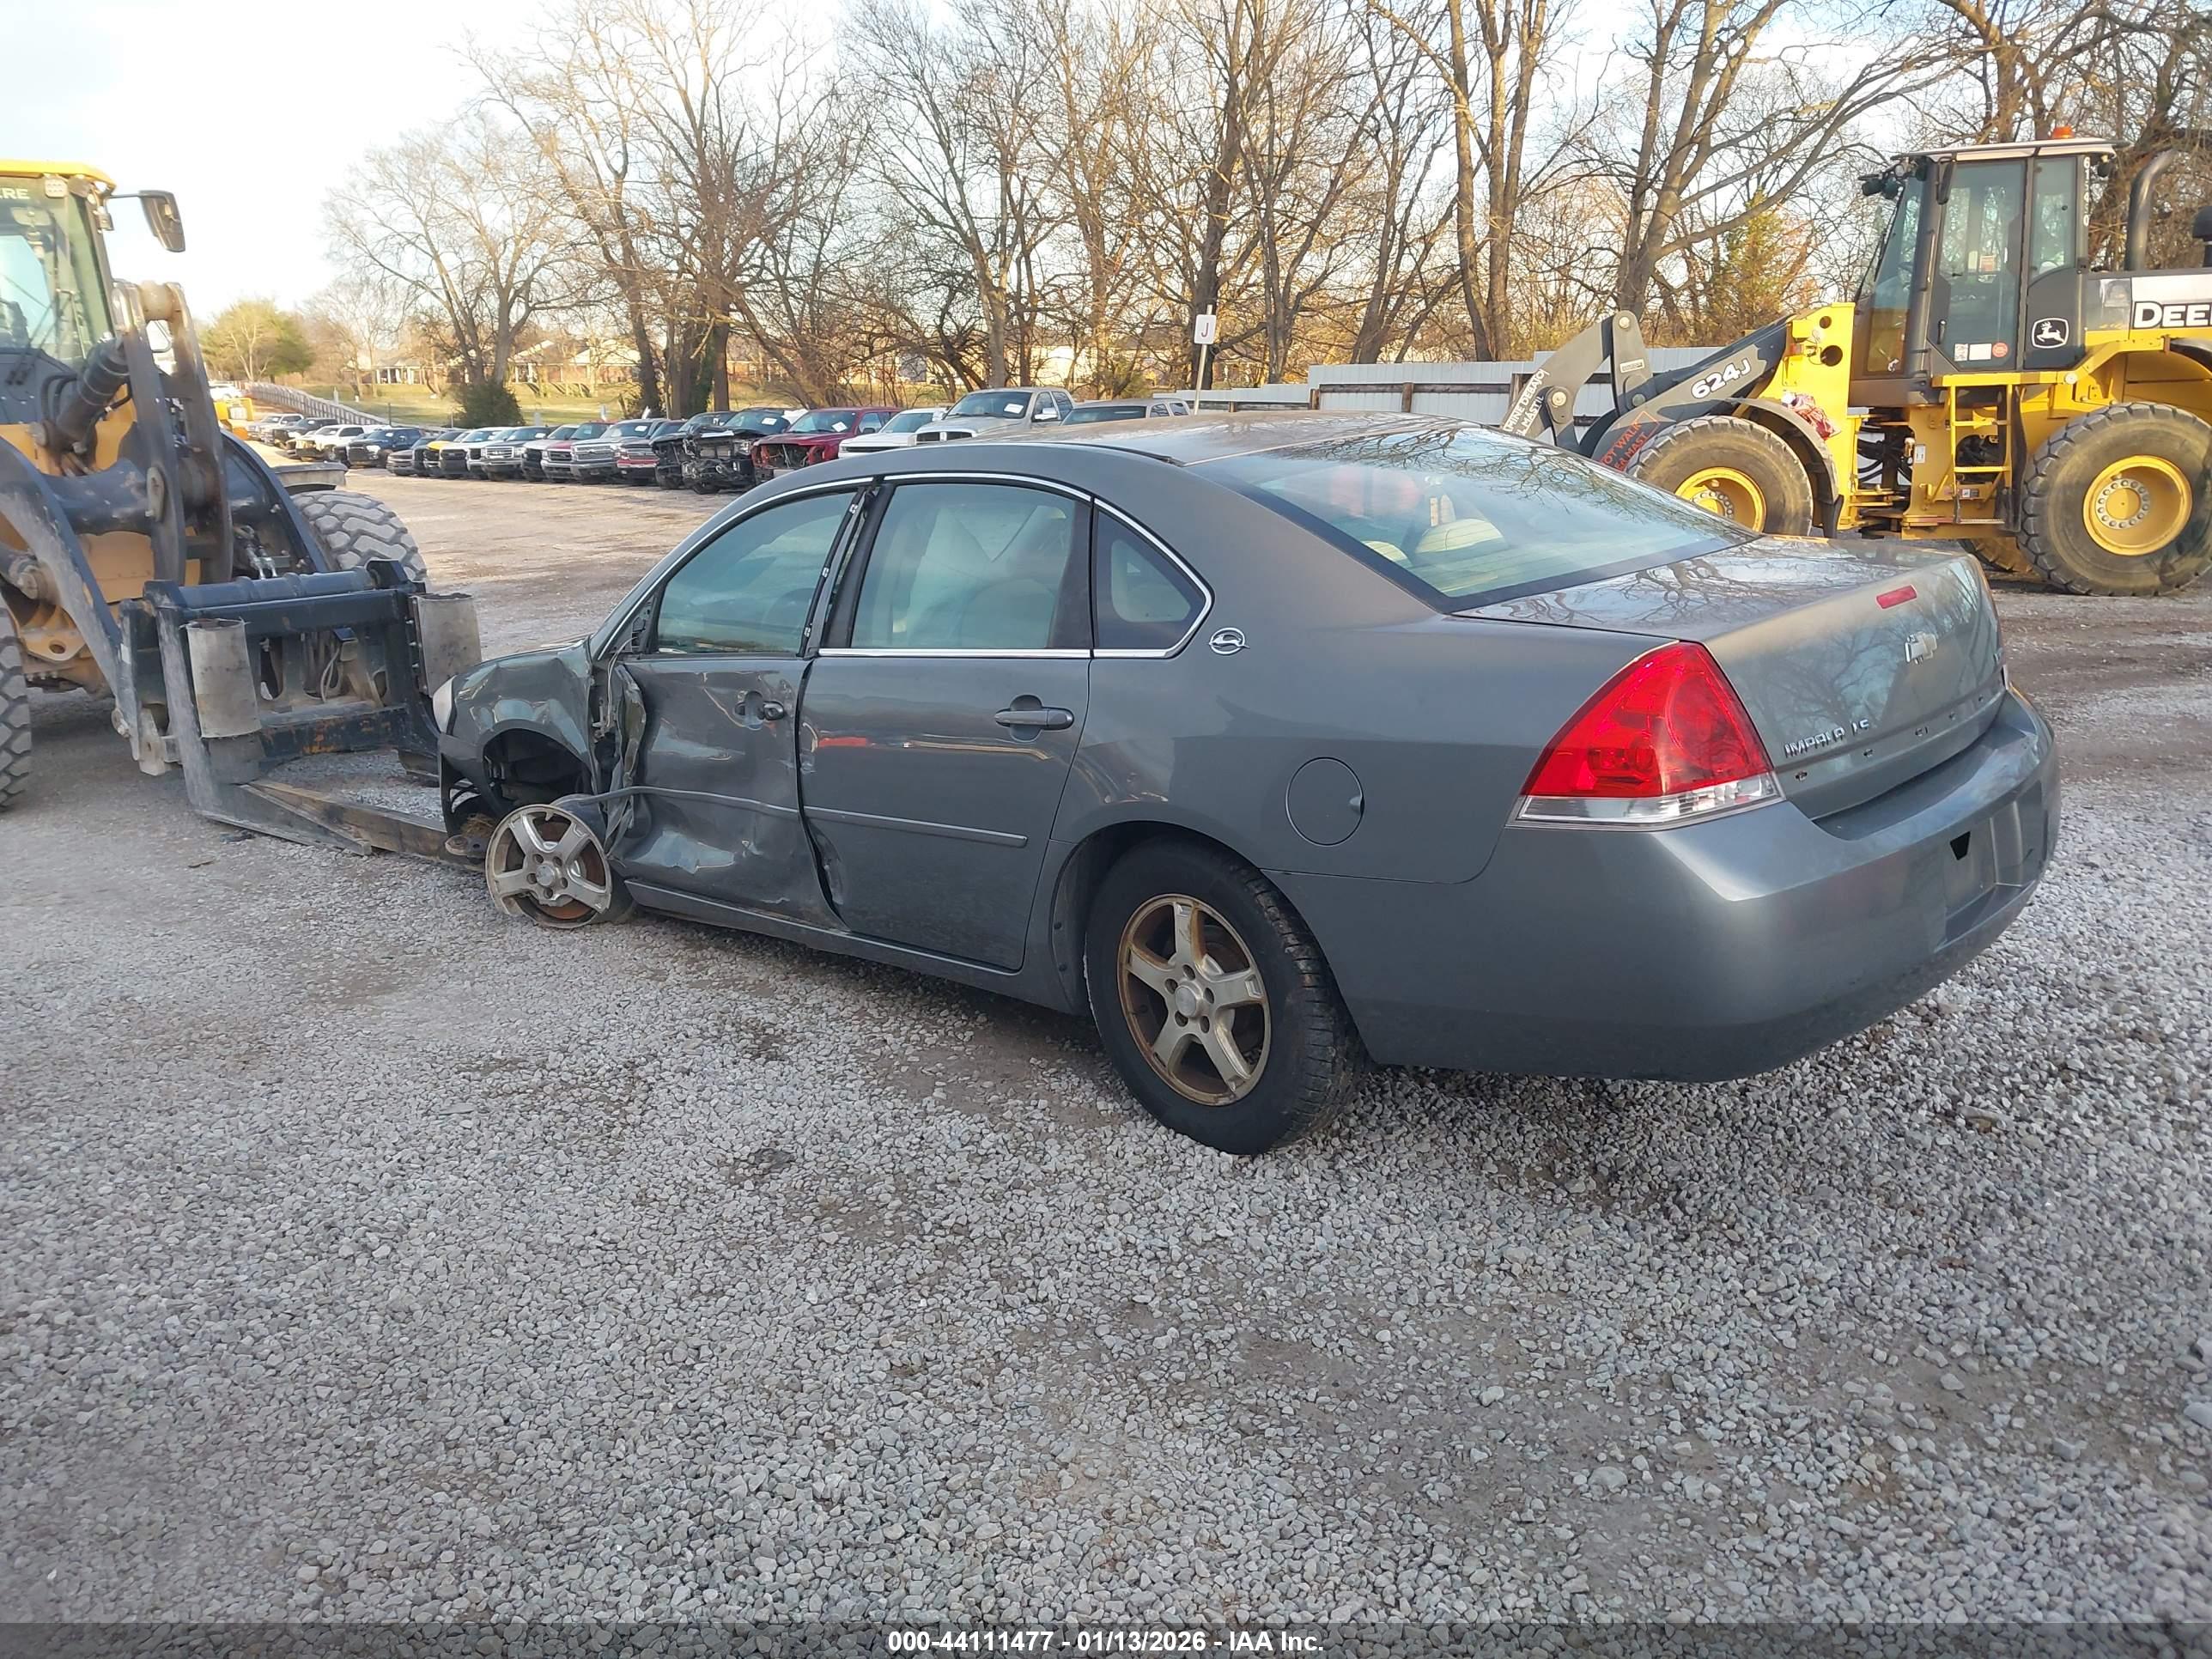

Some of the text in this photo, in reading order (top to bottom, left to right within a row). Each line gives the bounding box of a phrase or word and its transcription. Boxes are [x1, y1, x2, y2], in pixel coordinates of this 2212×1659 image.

[0, 187, 30, 199] RE
[2132, 301, 2212, 329] DEE
[1200, 322, 1209, 337] J
[1691, 357, 1751, 398] 624J
[1614, 422, 1642, 449] WALK
[1625, 432, 1648, 458] MAST
